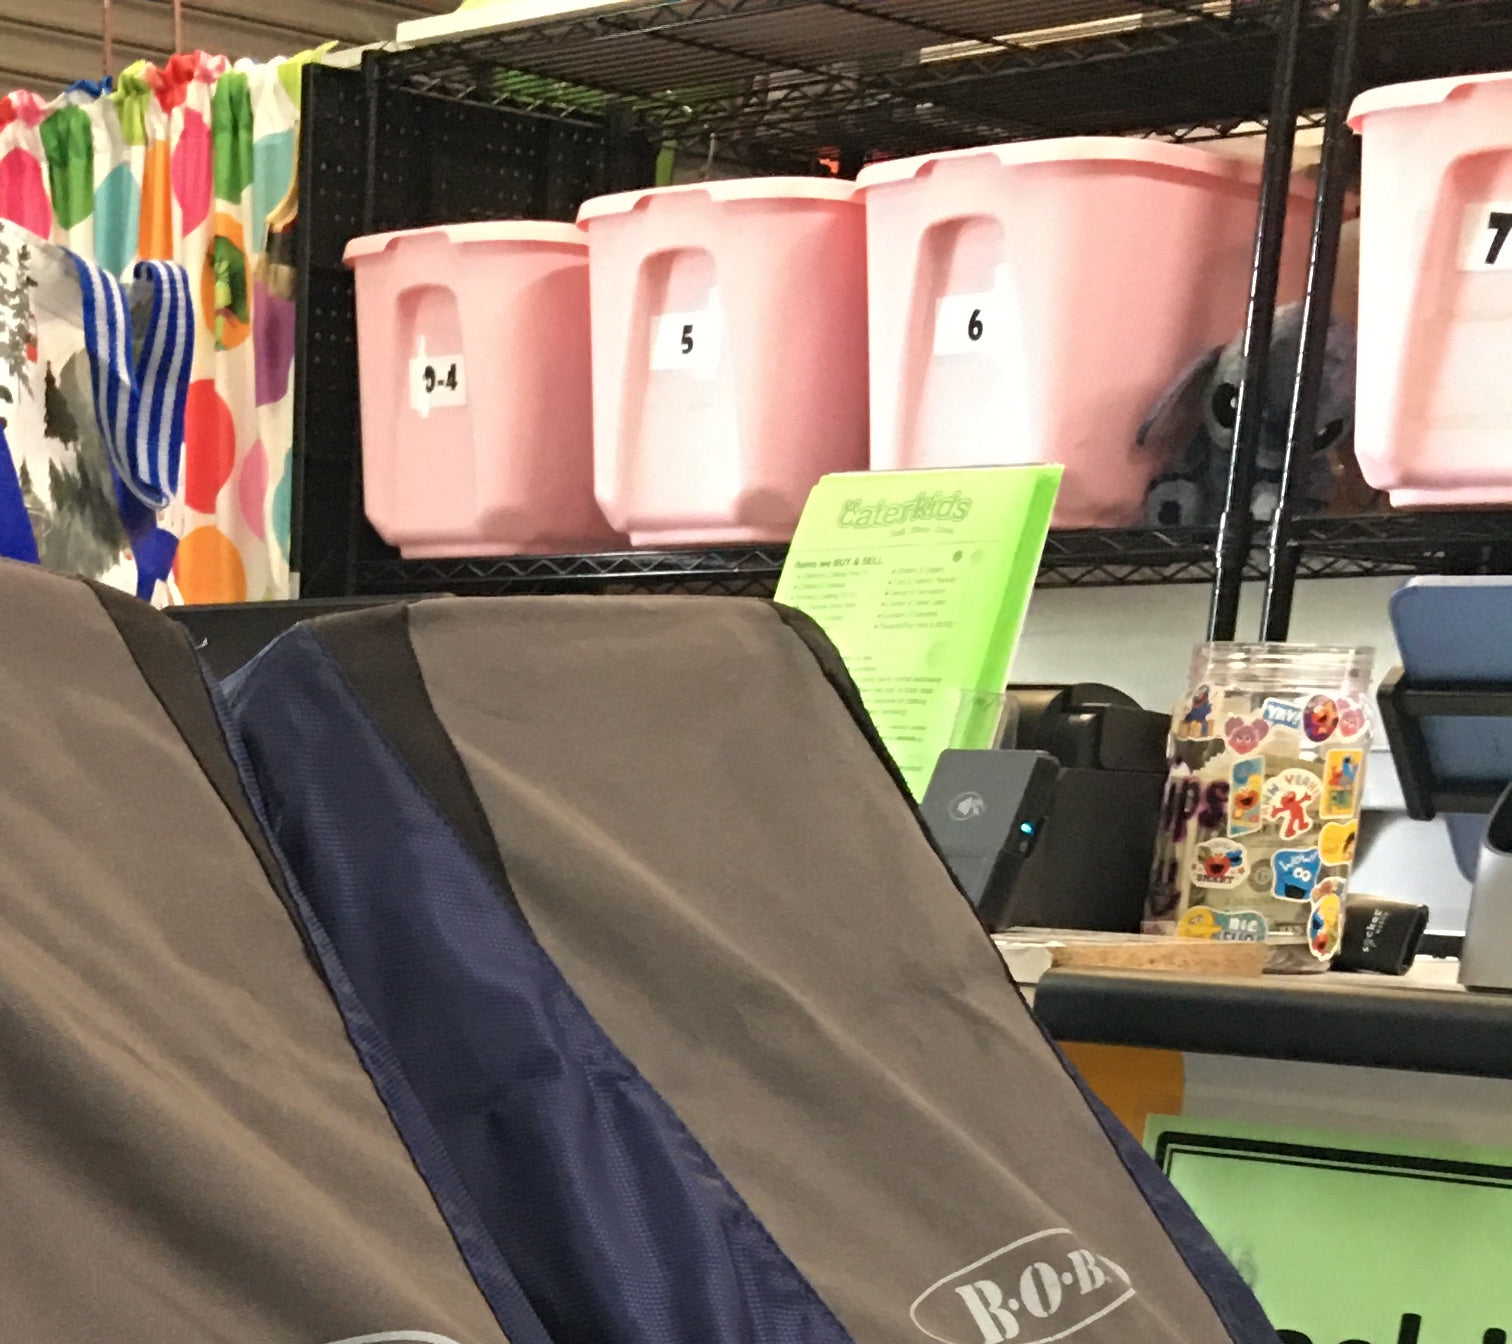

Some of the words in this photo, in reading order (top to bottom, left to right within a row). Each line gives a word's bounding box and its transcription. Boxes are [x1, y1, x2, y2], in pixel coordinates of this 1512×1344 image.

[681, 324, 694, 354] 5
[968, 308, 983, 341] 6
[833, 557, 852, 567] BUY
